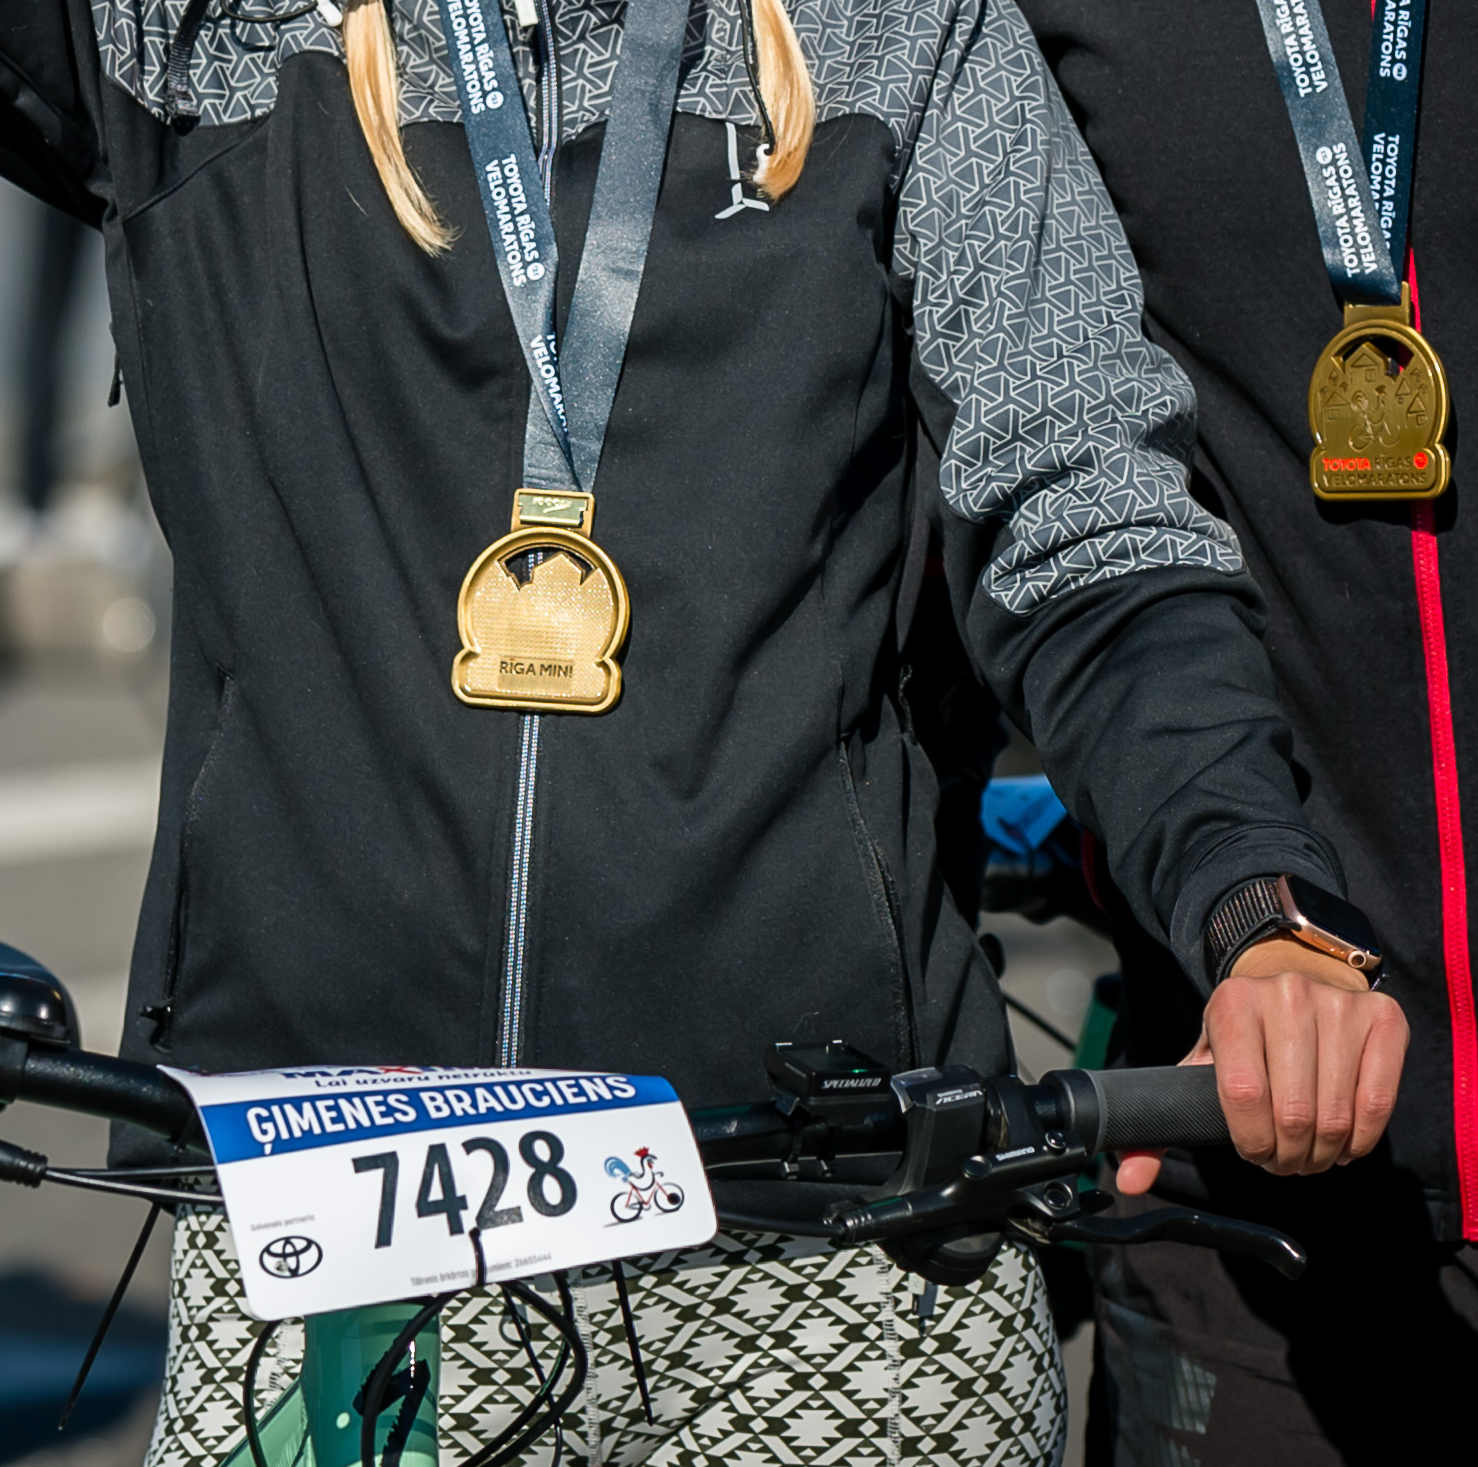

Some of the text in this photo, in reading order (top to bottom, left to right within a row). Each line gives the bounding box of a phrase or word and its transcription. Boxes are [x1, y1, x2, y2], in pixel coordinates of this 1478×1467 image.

[1395, 10, 1411, 60] RĪGAS
[475, 42, 499, 92] RĪGAS
[1284, 33, 1312, 98] TOYOTA
[1323, 165, 1346, 216] RĪGAS
[1383, 134, 1400, 197] TOYOTA
[485, 159, 527, 287] VELOMARATONS
[501, 154, 527, 215] TOYOTA
[515, 213, 539, 262] RĪGAS
[1332, 142, 1378, 275] VELOMARATONS
[1335, 214, 1361, 278] TOYOTA
[1322, 458, 1371, 472] TOYOTA
[1323, 473, 1427, 487] VELOMARATONS
[499, 658, 573, 678] RĪGA MIN!
[314, 1079, 348, 1087] Lai
[355, 1076, 430, 1085] uzvaru
[821, 1077, 882, 1089] SPECIALIZED
[246, 1076, 636, 1155] ĢIMENES BRAUCIENS
[351, 1129, 577, 1251] 7428
